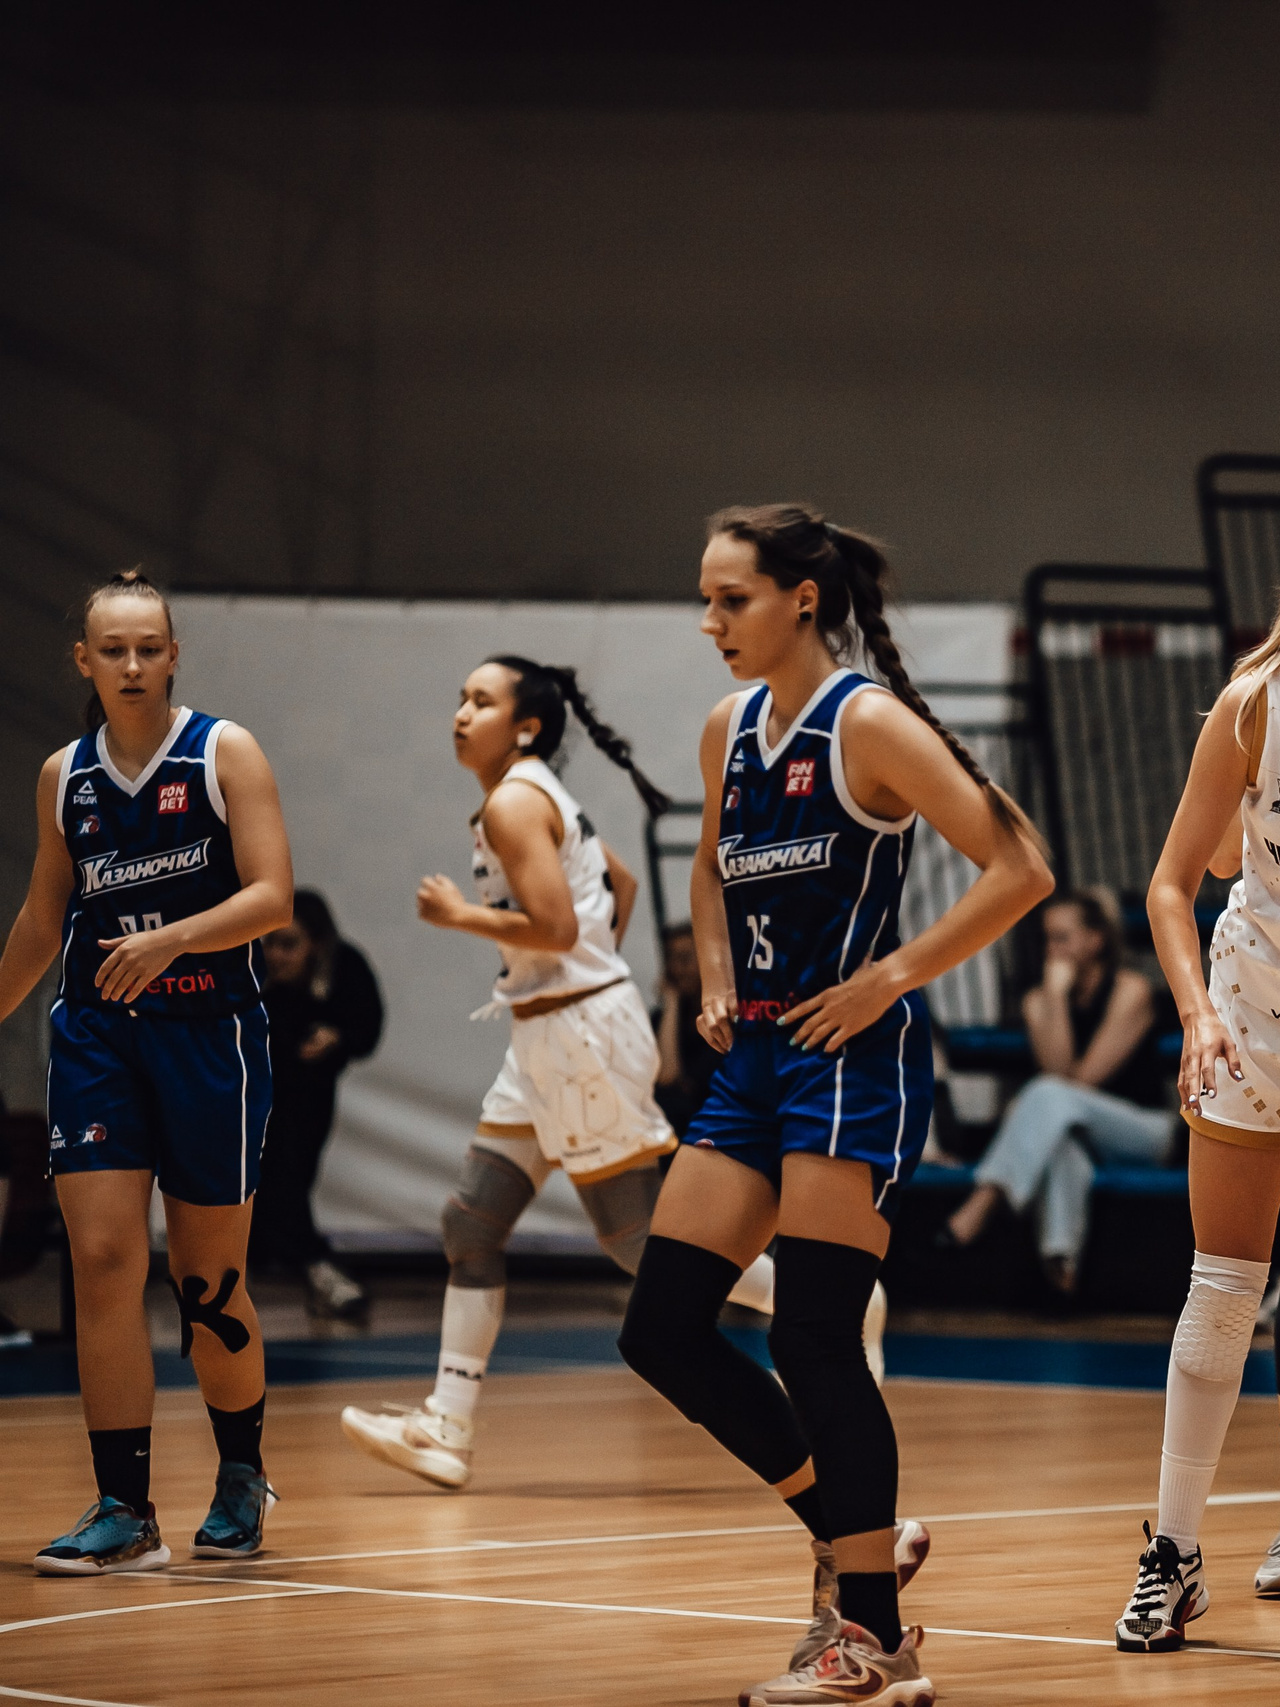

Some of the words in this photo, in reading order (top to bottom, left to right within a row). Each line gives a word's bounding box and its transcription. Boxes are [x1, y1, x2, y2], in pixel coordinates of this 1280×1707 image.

[73, 795, 98, 805] PEAK
[160, 784, 185, 800] FON
[159, 797, 186, 812] BET
[83, 846, 201, 893] КАЗАНОЧКА
[746, 914, 774, 971] 15
[142, 968, 215, 994] етай
